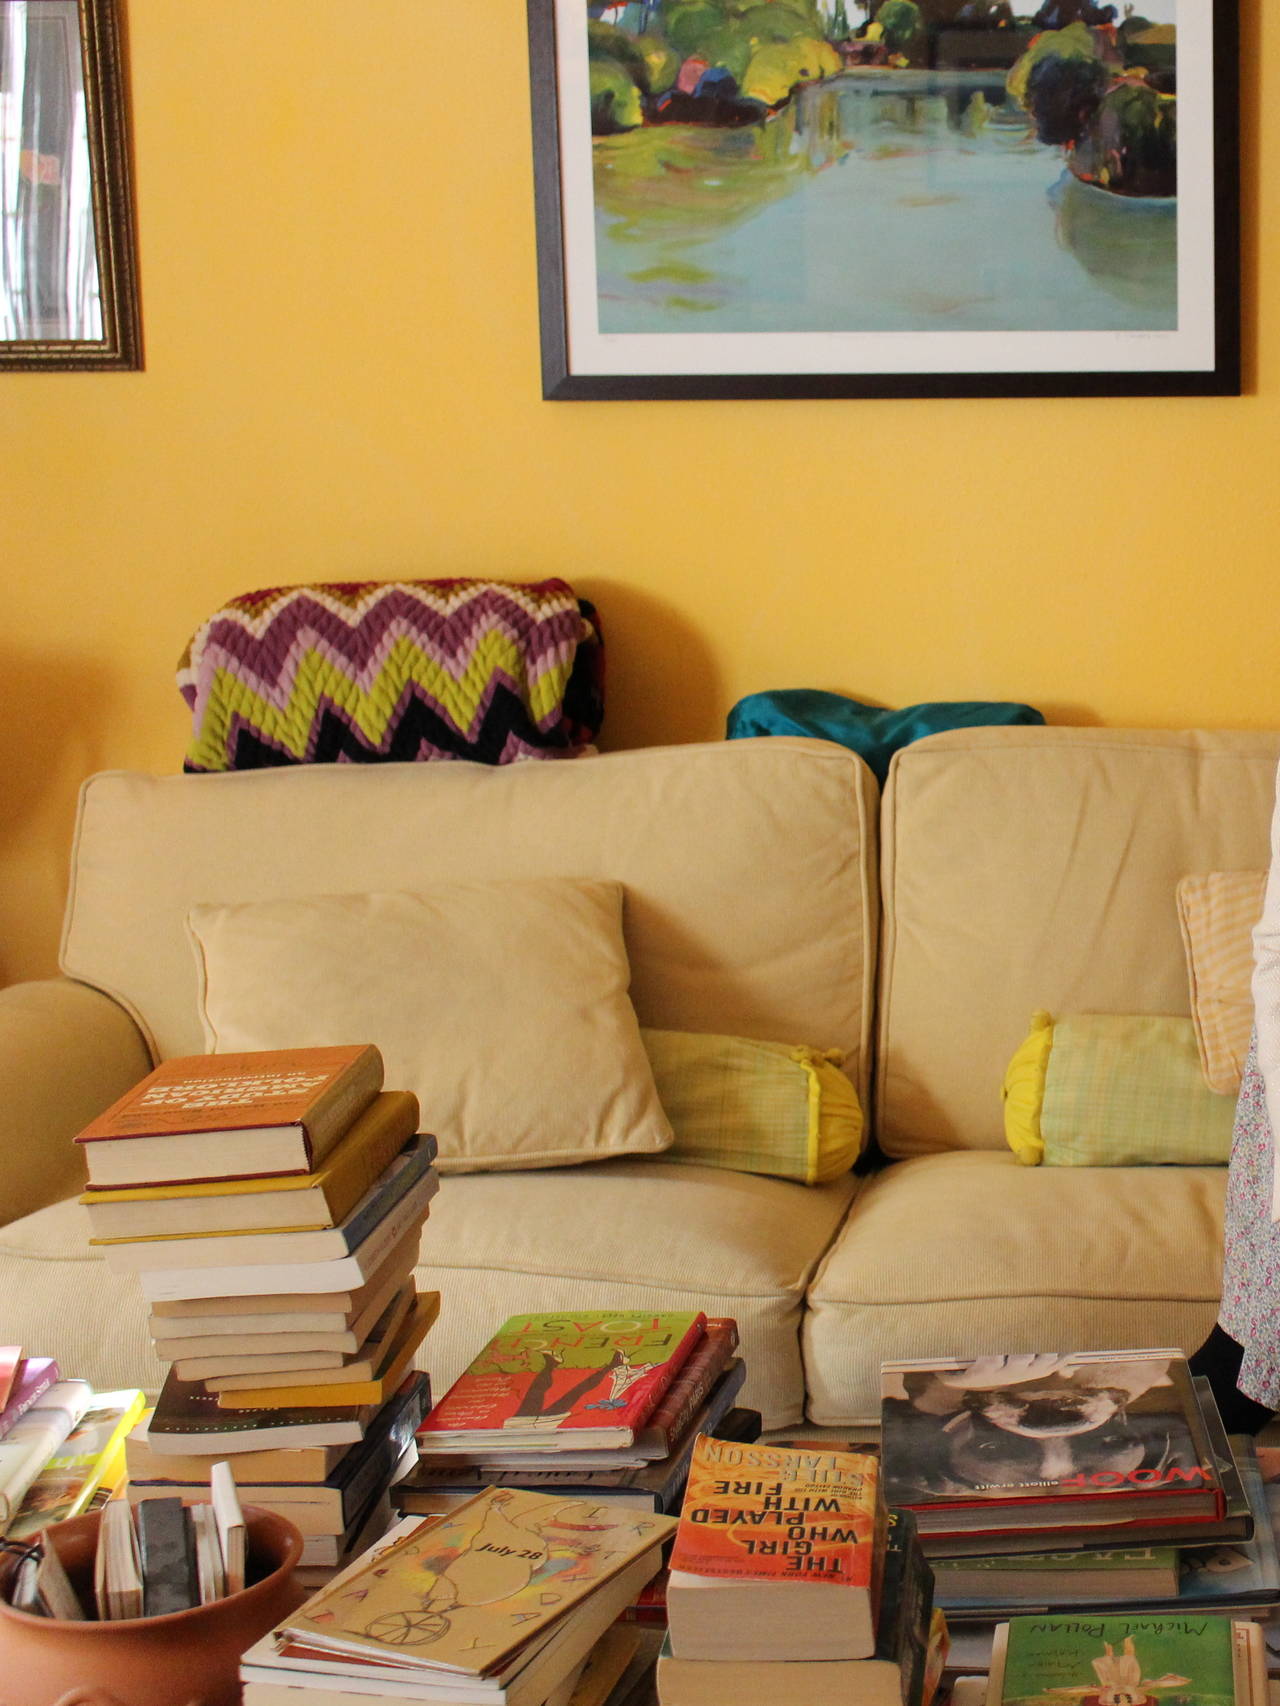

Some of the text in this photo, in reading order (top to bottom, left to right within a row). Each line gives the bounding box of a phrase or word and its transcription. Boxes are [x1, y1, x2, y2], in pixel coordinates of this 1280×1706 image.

[141, 1081, 321, 1100] AMERICAN
[146, 1074, 331, 1093] FOLKLORE
[139, 1088, 309, 1106] STUDY OF
[181, 1098, 254, 1109] THE
[514, 1318, 671, 1336] TOAST
[488, 1334, 673, 1351] FRENCH
[703, 1444, 837, 1470] LARSSON
[973, 1480, 1059, 1491] elliott erwitt
[1059, 1466, 1212, 1488] WOOF
[712, 1480, 783, 1496] FIRE
[763, 1496, 841, 1513] WITH
[691, 1508, 805, 1526] PLAYED
[787, 1526, 859, 1545] WHO
[476, 1543, 544, 1560] July 28
[740, 1539, 813, 1555] GIRL
[785, 1556, 845, 1575] THE
[1029, 1622, 1105, 1640] POLLAN
